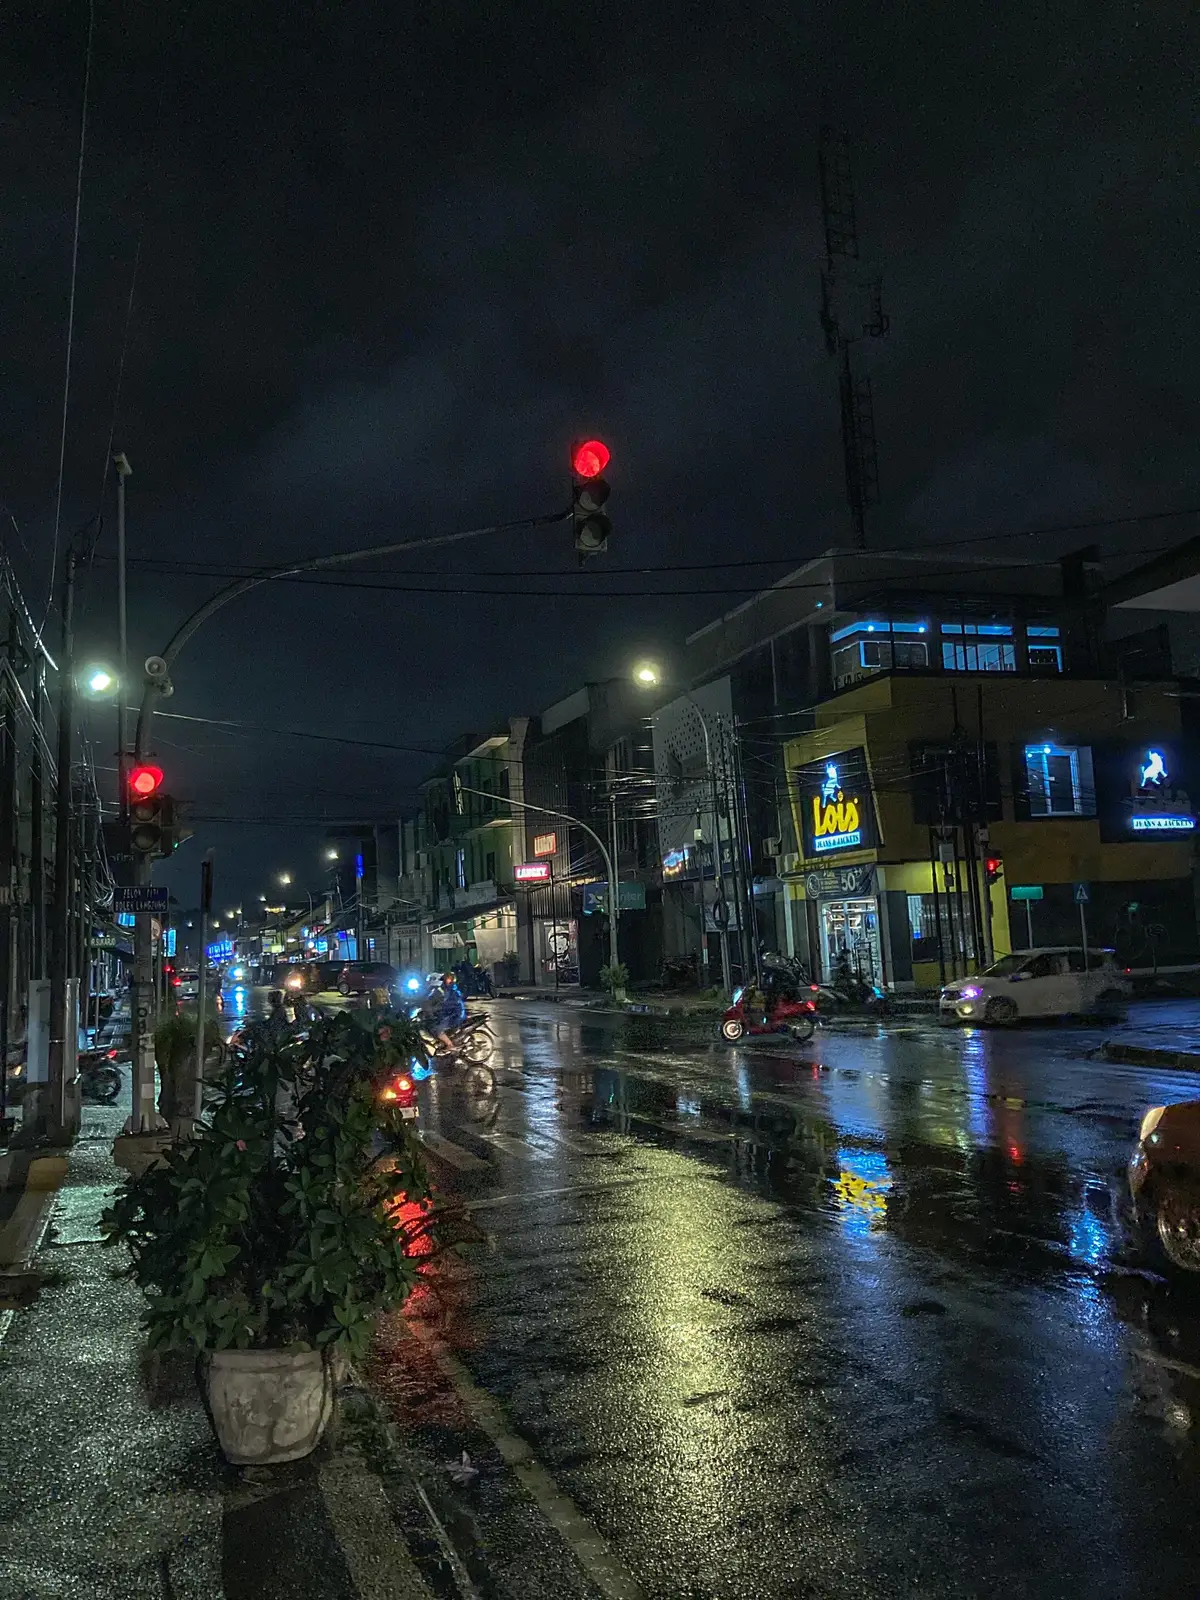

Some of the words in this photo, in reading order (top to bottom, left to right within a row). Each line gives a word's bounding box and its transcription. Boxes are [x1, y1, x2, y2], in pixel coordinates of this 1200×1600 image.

[813, 790, 860, 837] Lois
[817, 839, 831, 849] JEANS
[837, 836, 859, 846] JACKETS
[136, 900, 166, 911] LANGSUNG
